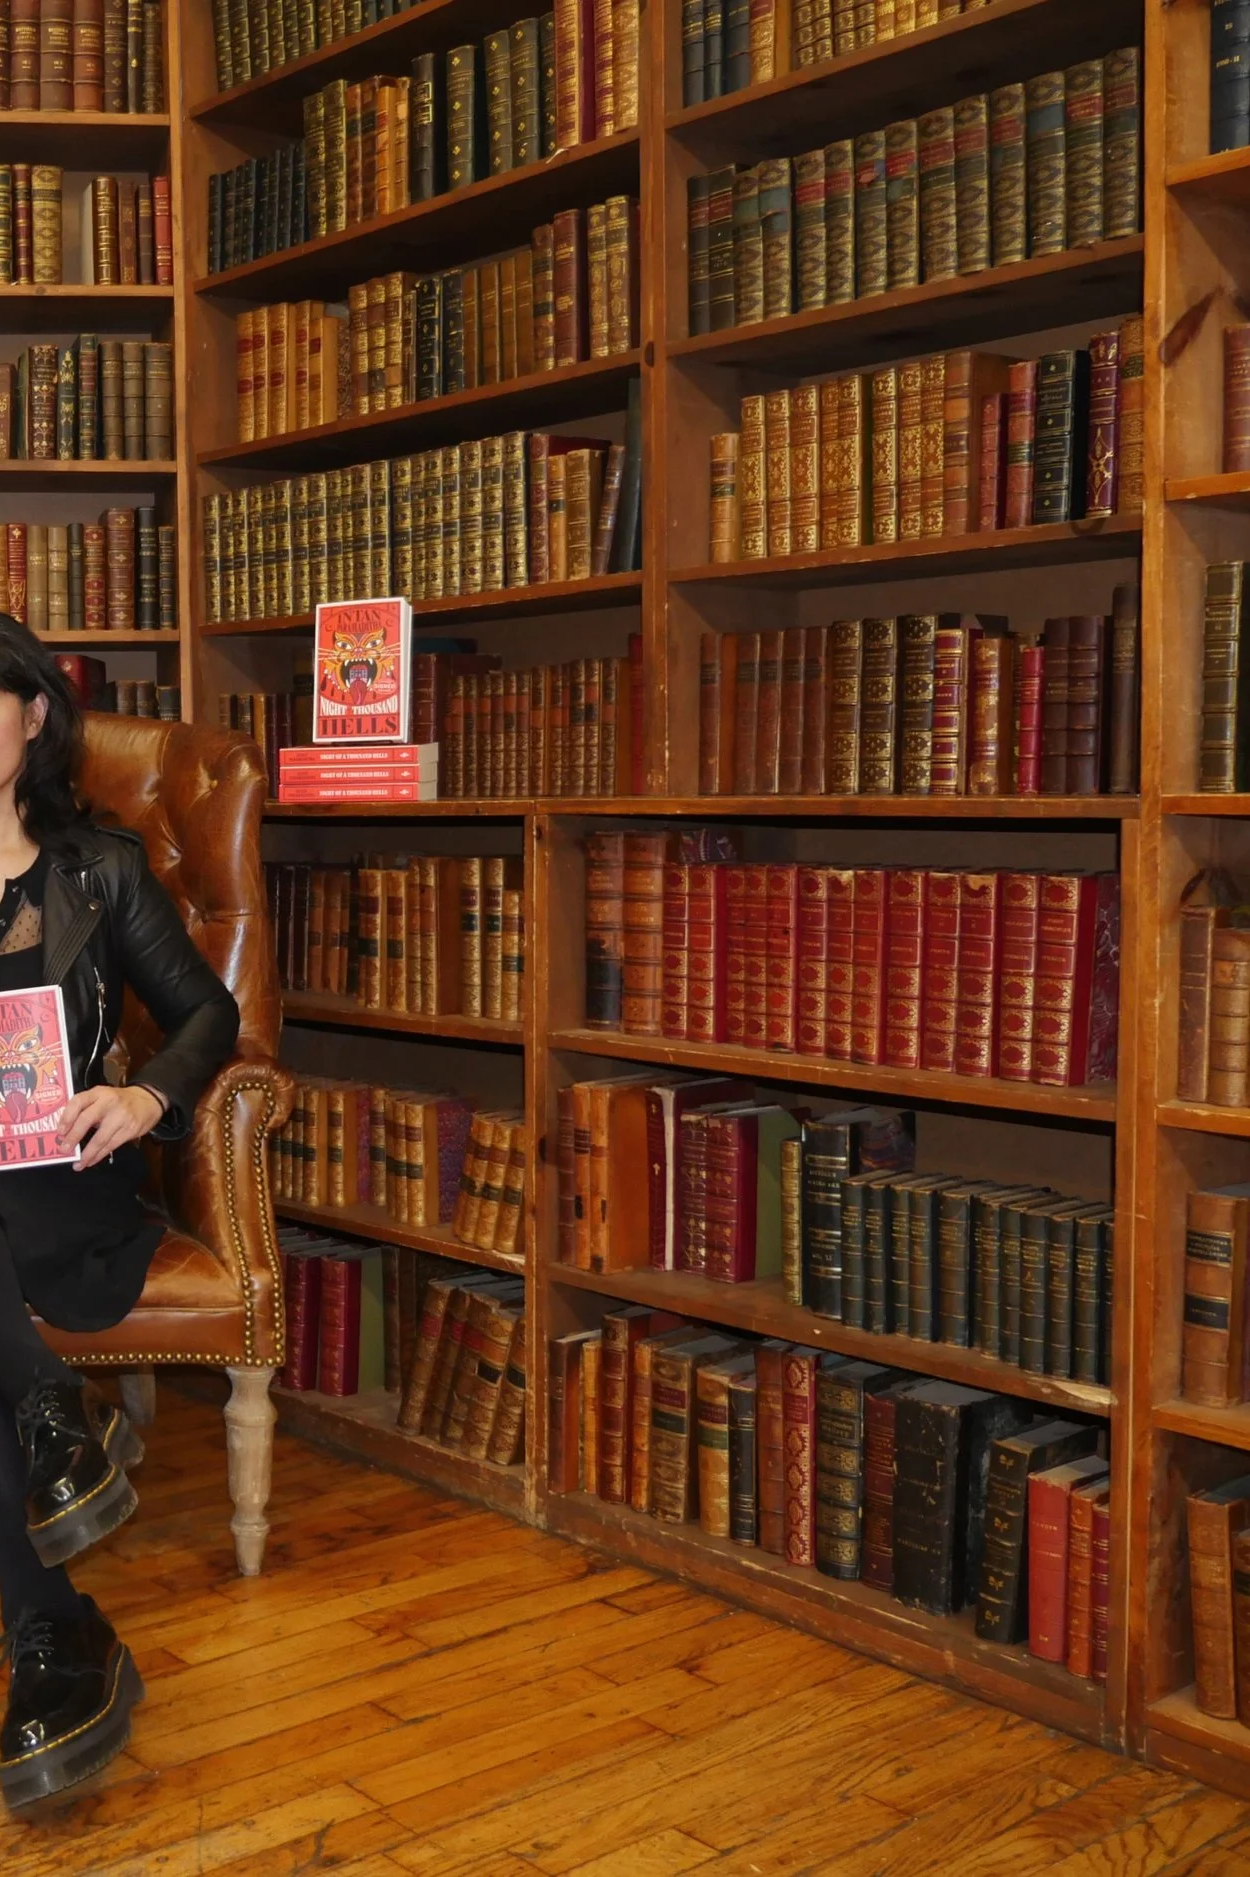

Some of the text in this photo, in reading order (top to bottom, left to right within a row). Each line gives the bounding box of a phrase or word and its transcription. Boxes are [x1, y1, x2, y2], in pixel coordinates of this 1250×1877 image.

[338, 610, 381, 624] INTAN
[320, 695, 398, 716] NIGHT THOUSAND
[321, 716, 397, 735] HELLS
[12, 1107, 66, 1135] THOUSAN
